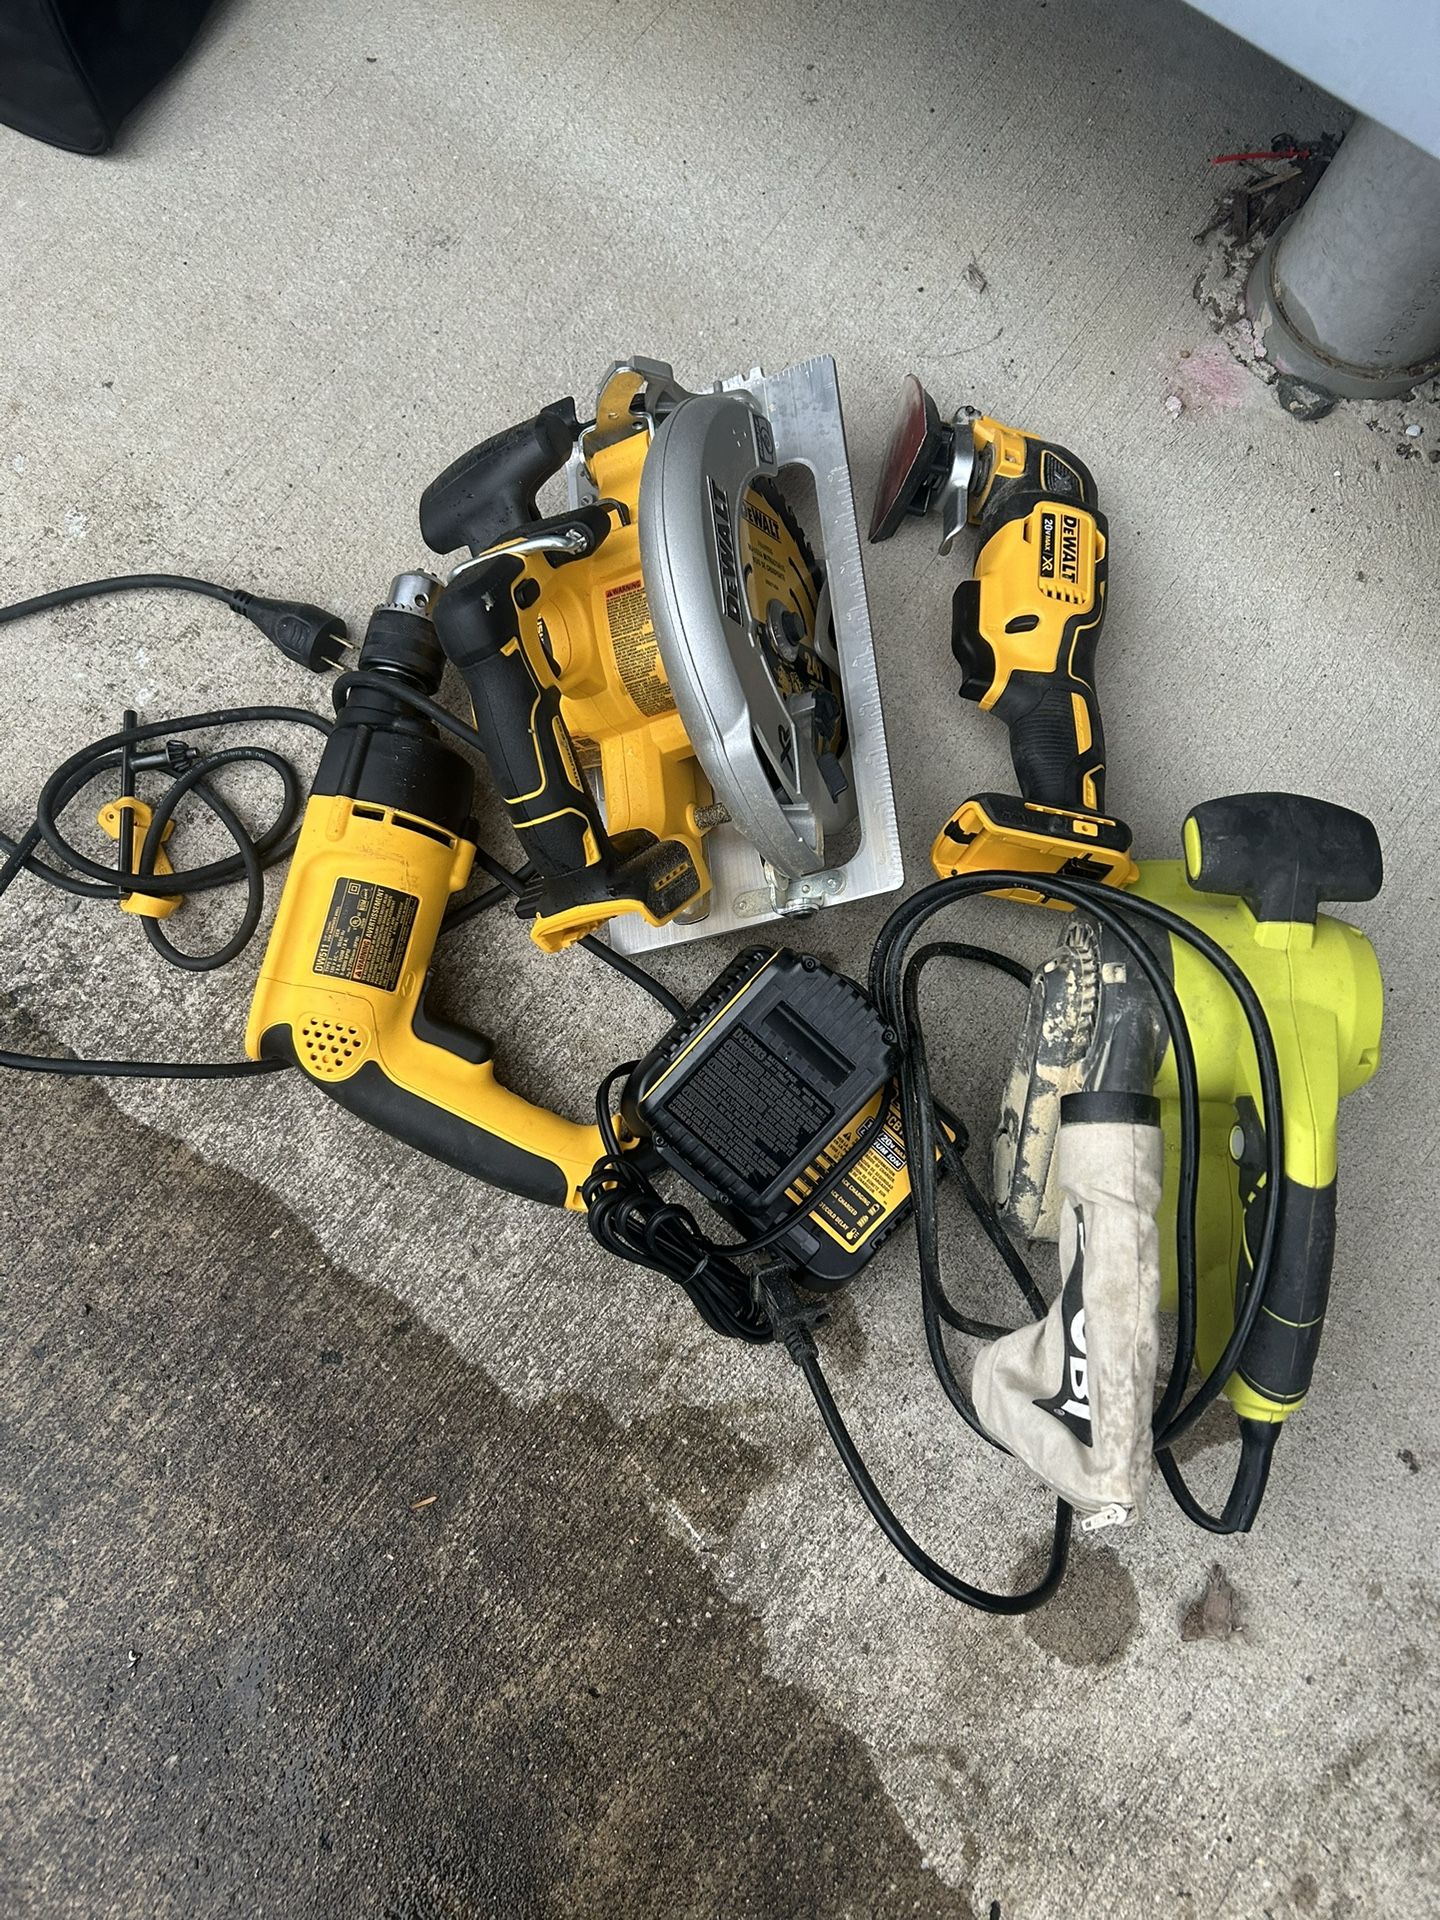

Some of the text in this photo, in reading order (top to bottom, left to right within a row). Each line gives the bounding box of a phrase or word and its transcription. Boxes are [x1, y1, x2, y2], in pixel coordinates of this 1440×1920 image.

[710, 478, 743, 626] DEWALT
[1042, 556, 1053, 571] XR
[1062, 515, 1077, 583] DEWALT
[612, 580, 641, 595] WARNING
[780, 722, 793, 771] XR
[356, 940, 370, 970] WARNING
[365, 888, 384, 938] AVERTISSEMENT
[314, 943, 329, 971] DW511
[732, 1027, 768, 1060] DCB203
[731, 1046, 764, 1077] WARNING
[714, 1065, 767, 1112] AVERTISSEMENT
[688, 1092, 733, 1132] ADVERTENCIA
[886, 1153, 901, 1167] ION
[836, 1195, 858, 1216] CHARGED
[847, 1184, 871, 1206] CHARGING
[834, 1216, 849, 1230] DELAY
